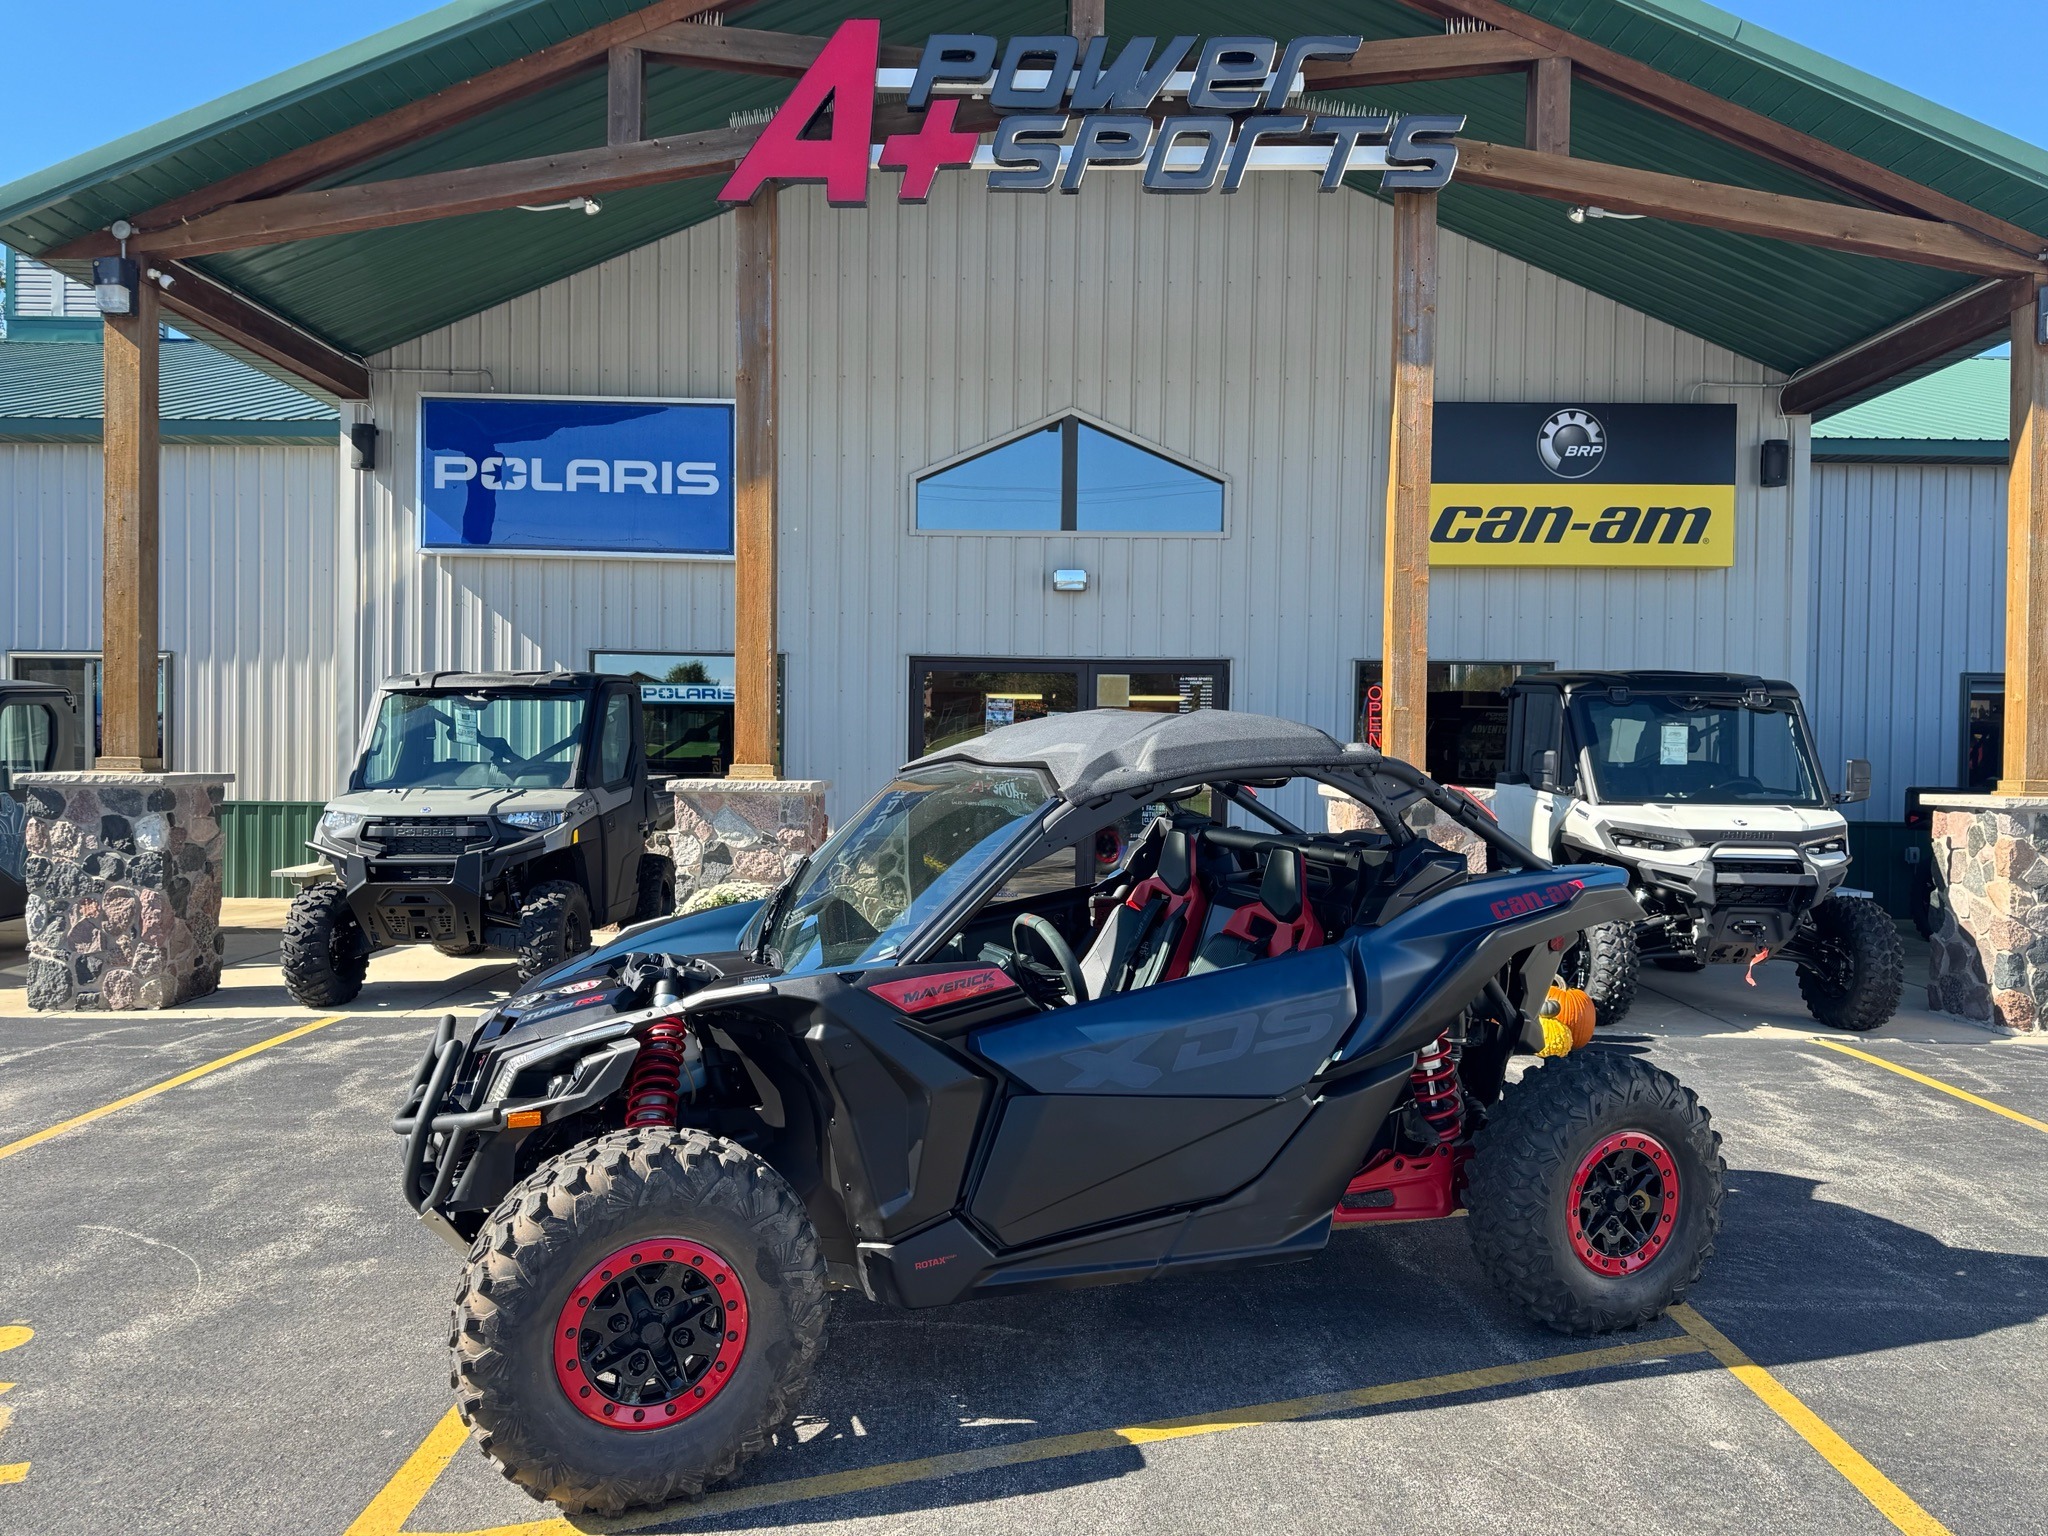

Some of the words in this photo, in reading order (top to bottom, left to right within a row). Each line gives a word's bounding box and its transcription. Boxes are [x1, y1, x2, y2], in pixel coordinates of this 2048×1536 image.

[715, 18, 980, 207] A+
[1565, 445, 1603, 457] BRP
[433, 456, 720, 496] POLARIS
[1429, 506, 1712, 545] can-am
[642, 687, 735, 700] POLARIS
[1367, 685, 1383, 748] OPEN
[1472, 725, 1507, 734] ADVENTU
[396, 827, 455, 836] POLARIS
[903, 971, 996, 1004] MAVERICK
[523, 1002, 575, 1021] TURBO
[1060, 992, 1342, 1089] XDS
[915, 1256, 946, 1270] ROTAX
